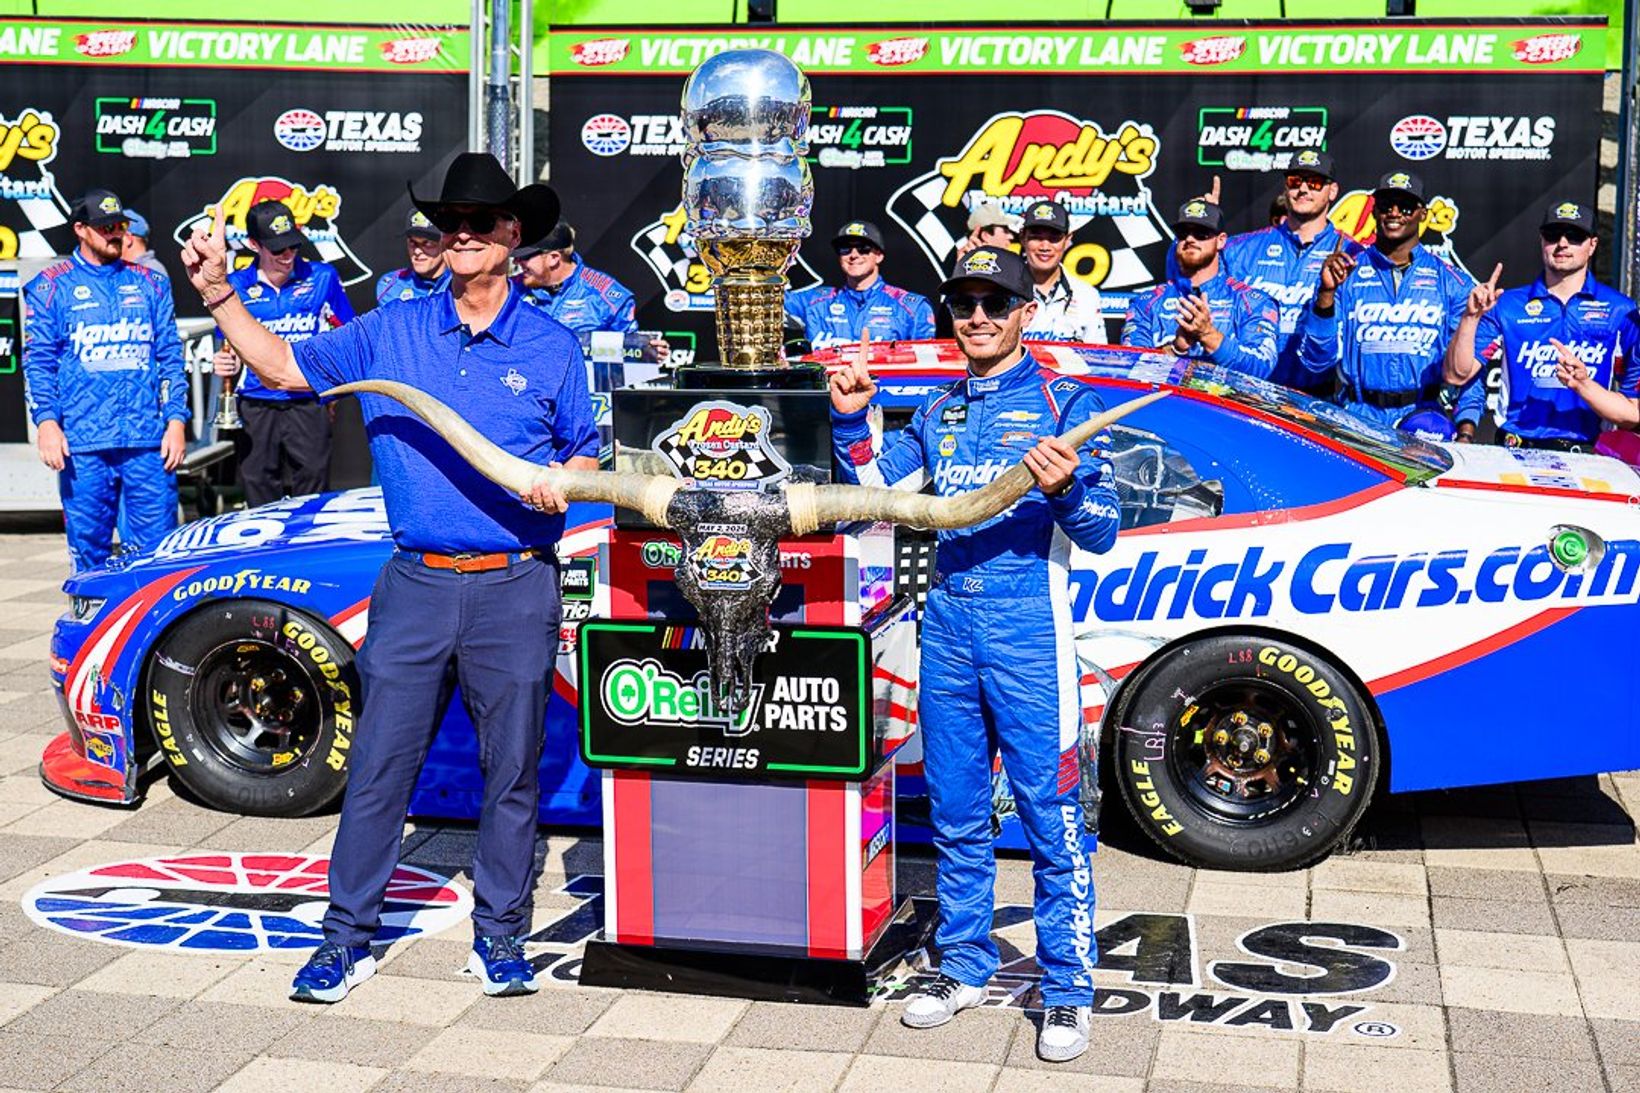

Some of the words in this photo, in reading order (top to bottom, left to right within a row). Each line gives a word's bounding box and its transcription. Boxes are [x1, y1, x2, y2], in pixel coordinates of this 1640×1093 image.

[0, 27, 61, 55] ANE
[148, 30, 284, 61] VICTORY
[285, 33, 368, 63] LANE
[940, 37, 1079, 66] VICTORY
[1079, 36, 1166, 65] LANE
[1258, 35, 1402, 64] VICTORY
[1405, 34, 1498, 64] LANE
[96, 114, 147, 135] DASH
[145, 110, 166, 139] 4
[167, 116, 216, 136] CASH
[325, 111, 423, 141] TEXAS
[630, 115, 686, 144] TEX
[842, 118, 863, 149] 4
[863, 126, 912, 145] CASH
[1200, 125, 1251, 146] DASH
[1250, 120, 1274, 150] 4
[1274, 125, 1326, 147] CASH
[1446, 116, 1556, 147] TEXAS
[0, 112, 56, 172] y's
[1445, 147, 1488, 160] MOTOR
[940, 115, 1156, 208] Andy's
[0, 172, 53, 200] tard
[207, 179, 338, 236] Ay's
[258, 312, 317, 333] ndrick
[1516, 340, 1608, 369] Henrick
[678, 408, 761, 447] Andy's
[693, 459, 747, 480] 340
[641, 540, 684, 567] O'Re
[779, 551, 812, 570] RTS
[696, 537, 751, 561] Andy's
[173, 569, 312, 600] GOODYEAR
[706, 569, 741, 582] 340
[1069, 545, 1285, 623] ndrick
[281, 621, 353, 772] GOODYEAR
[772, 676, 840, 704] AUTO
[152, 689, 188, 767] EAGLE
[765, 704, 848, 731] PARTS
[1258, 646, 1355, 796] GOODYEAR
[686, 746, 760, 769] SERIES
[1131, 759, 1185, 836] EAGLE
